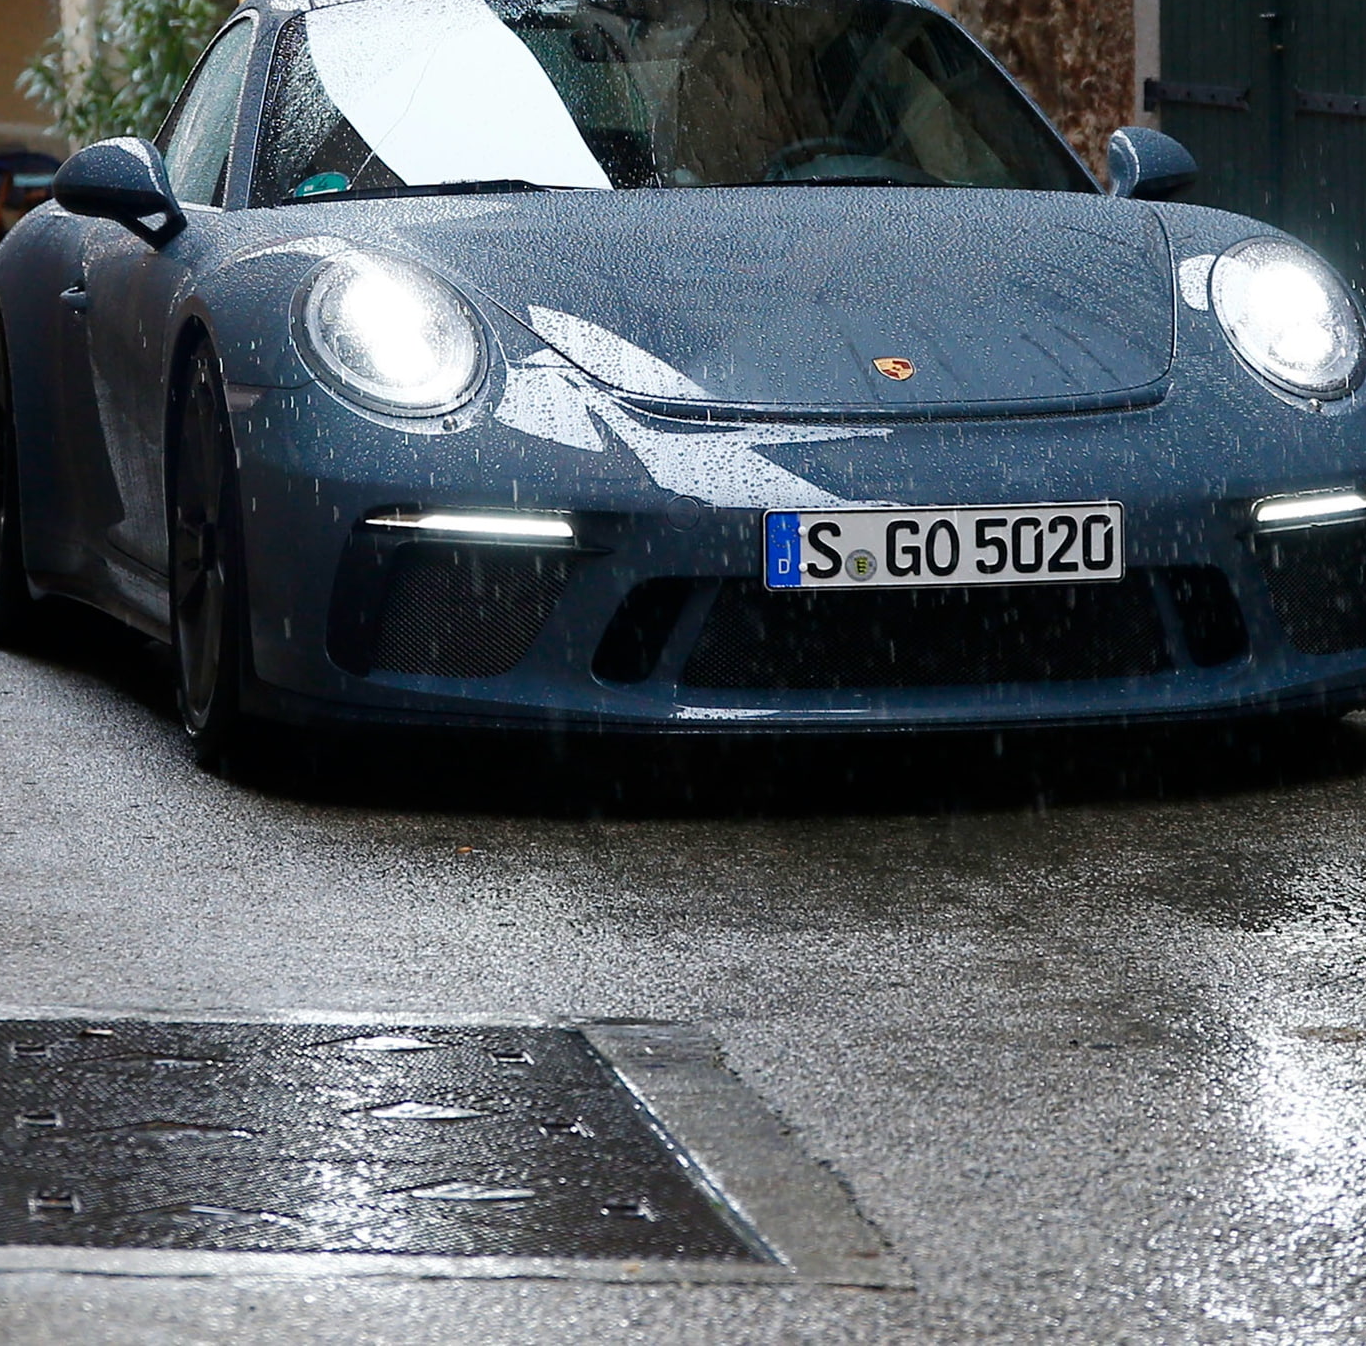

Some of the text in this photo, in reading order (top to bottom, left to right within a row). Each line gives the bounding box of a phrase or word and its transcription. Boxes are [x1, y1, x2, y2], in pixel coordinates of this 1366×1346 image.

[778, 558, 791, 575] D
[806, 514, 1114, 579] S GO 5020
